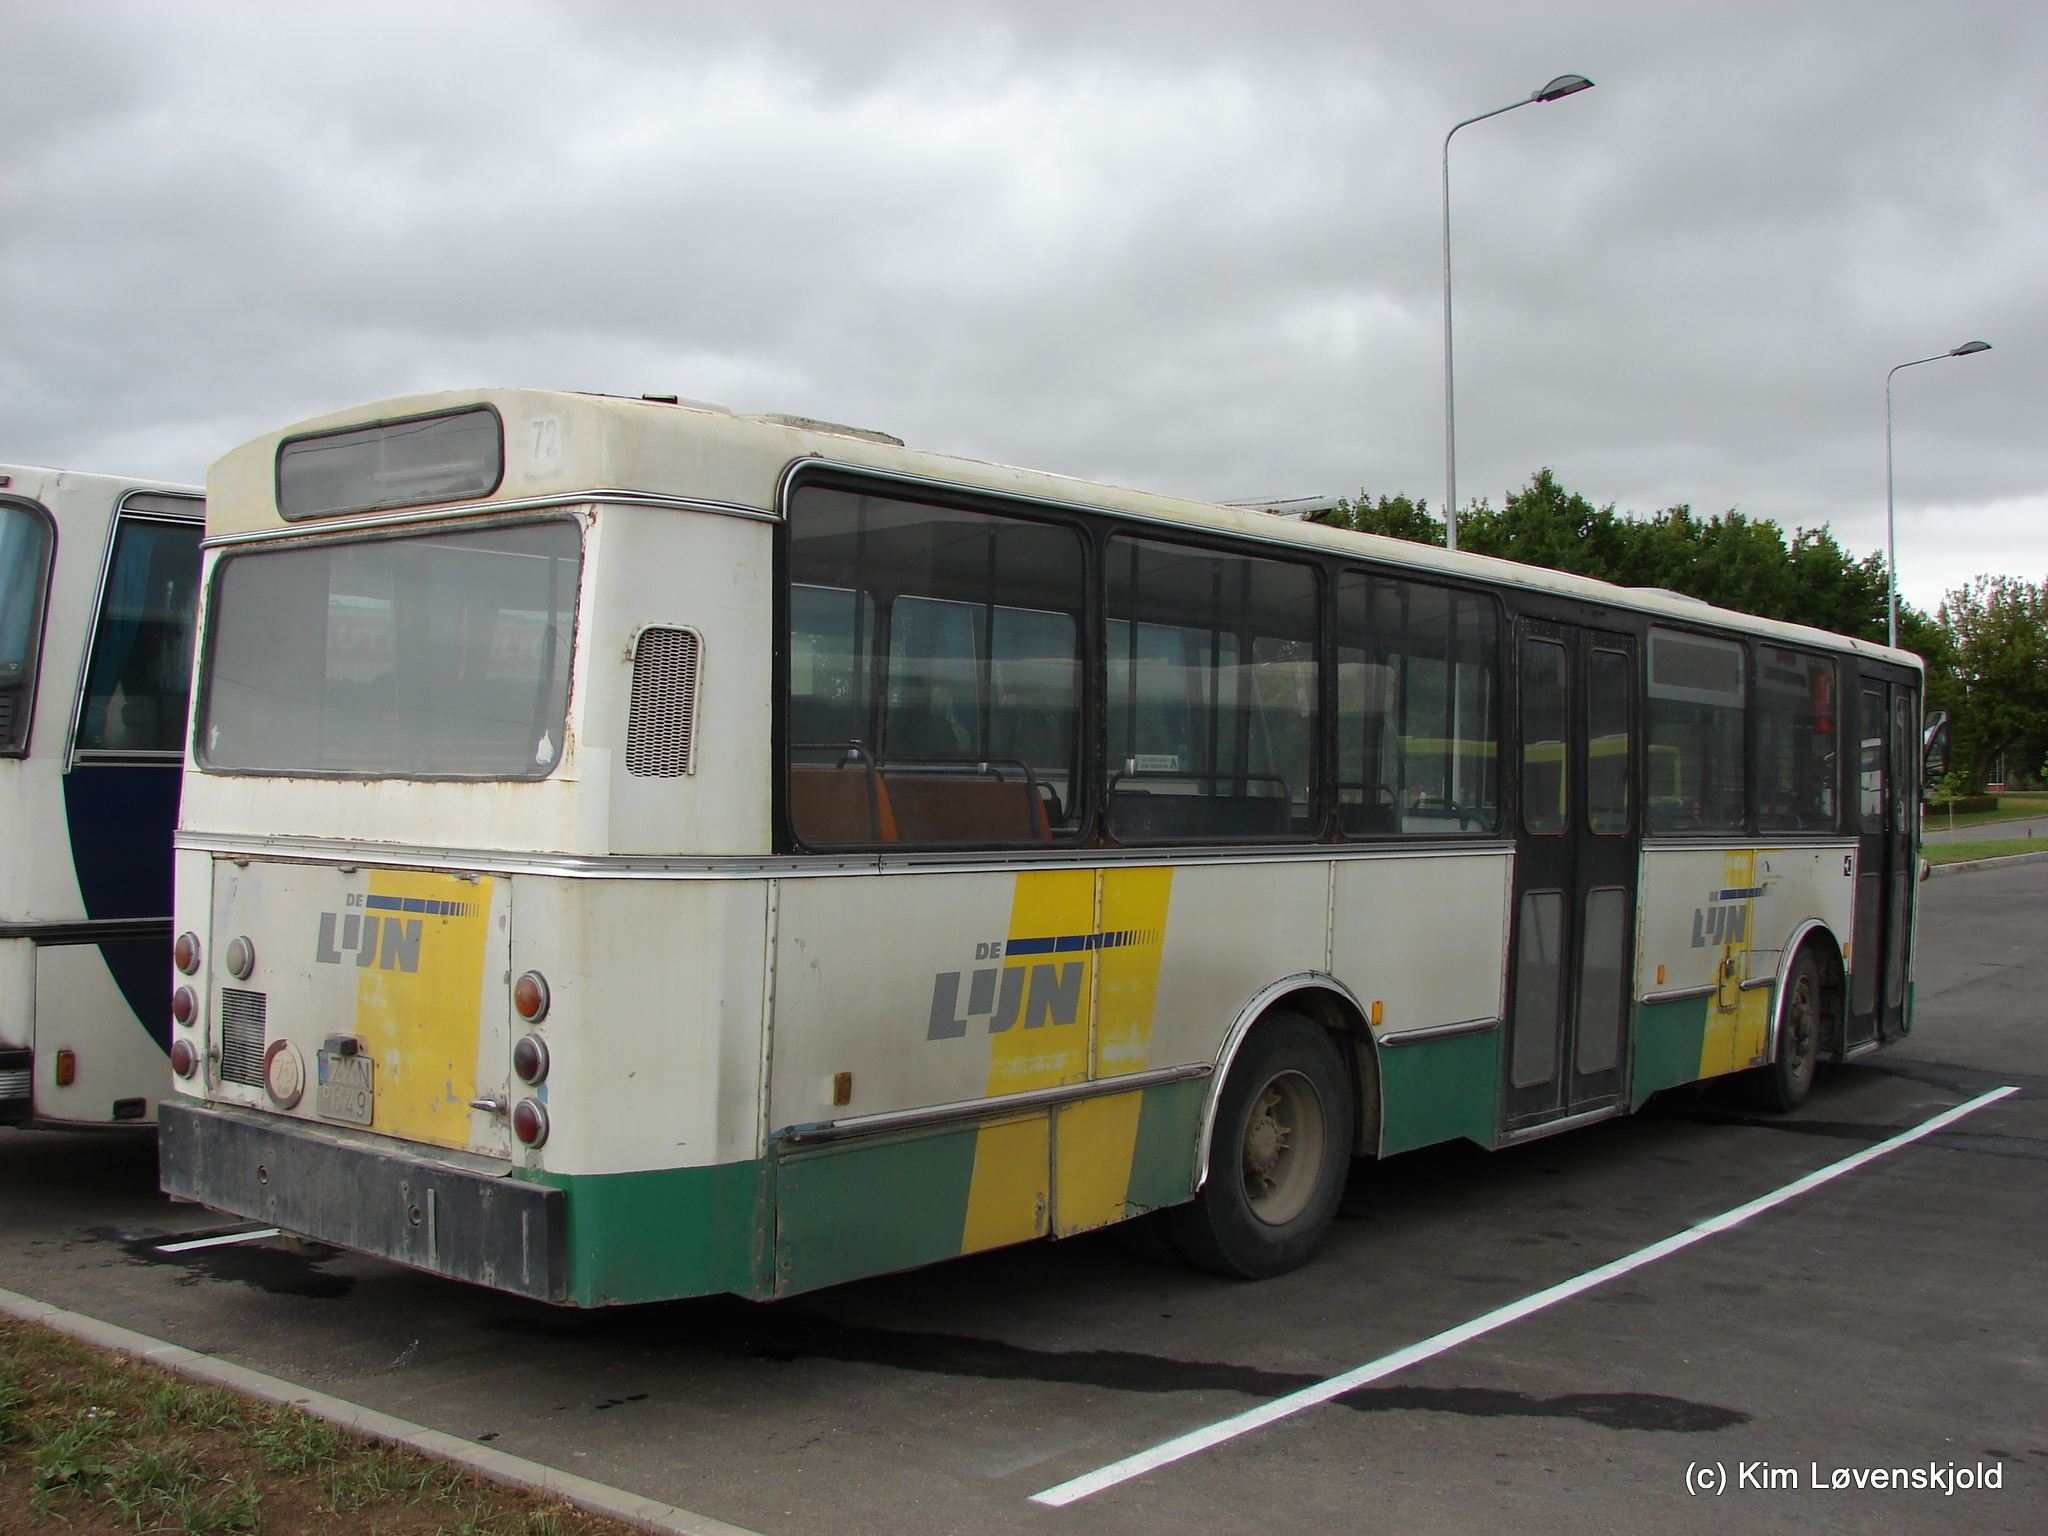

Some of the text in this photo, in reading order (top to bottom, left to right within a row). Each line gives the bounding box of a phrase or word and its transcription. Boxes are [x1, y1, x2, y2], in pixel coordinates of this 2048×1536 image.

[532, 418, 559, 458] 72
[346, 893, 363, 907] DE
[1709, 891, 1719, 902] DE
[316, 912, 423, 973] LIJN
[1691, 905, 1747, 948] LIJN
[975, 942, 1001, 960] DE
[926, 961, 1085, 1042] LIJN
